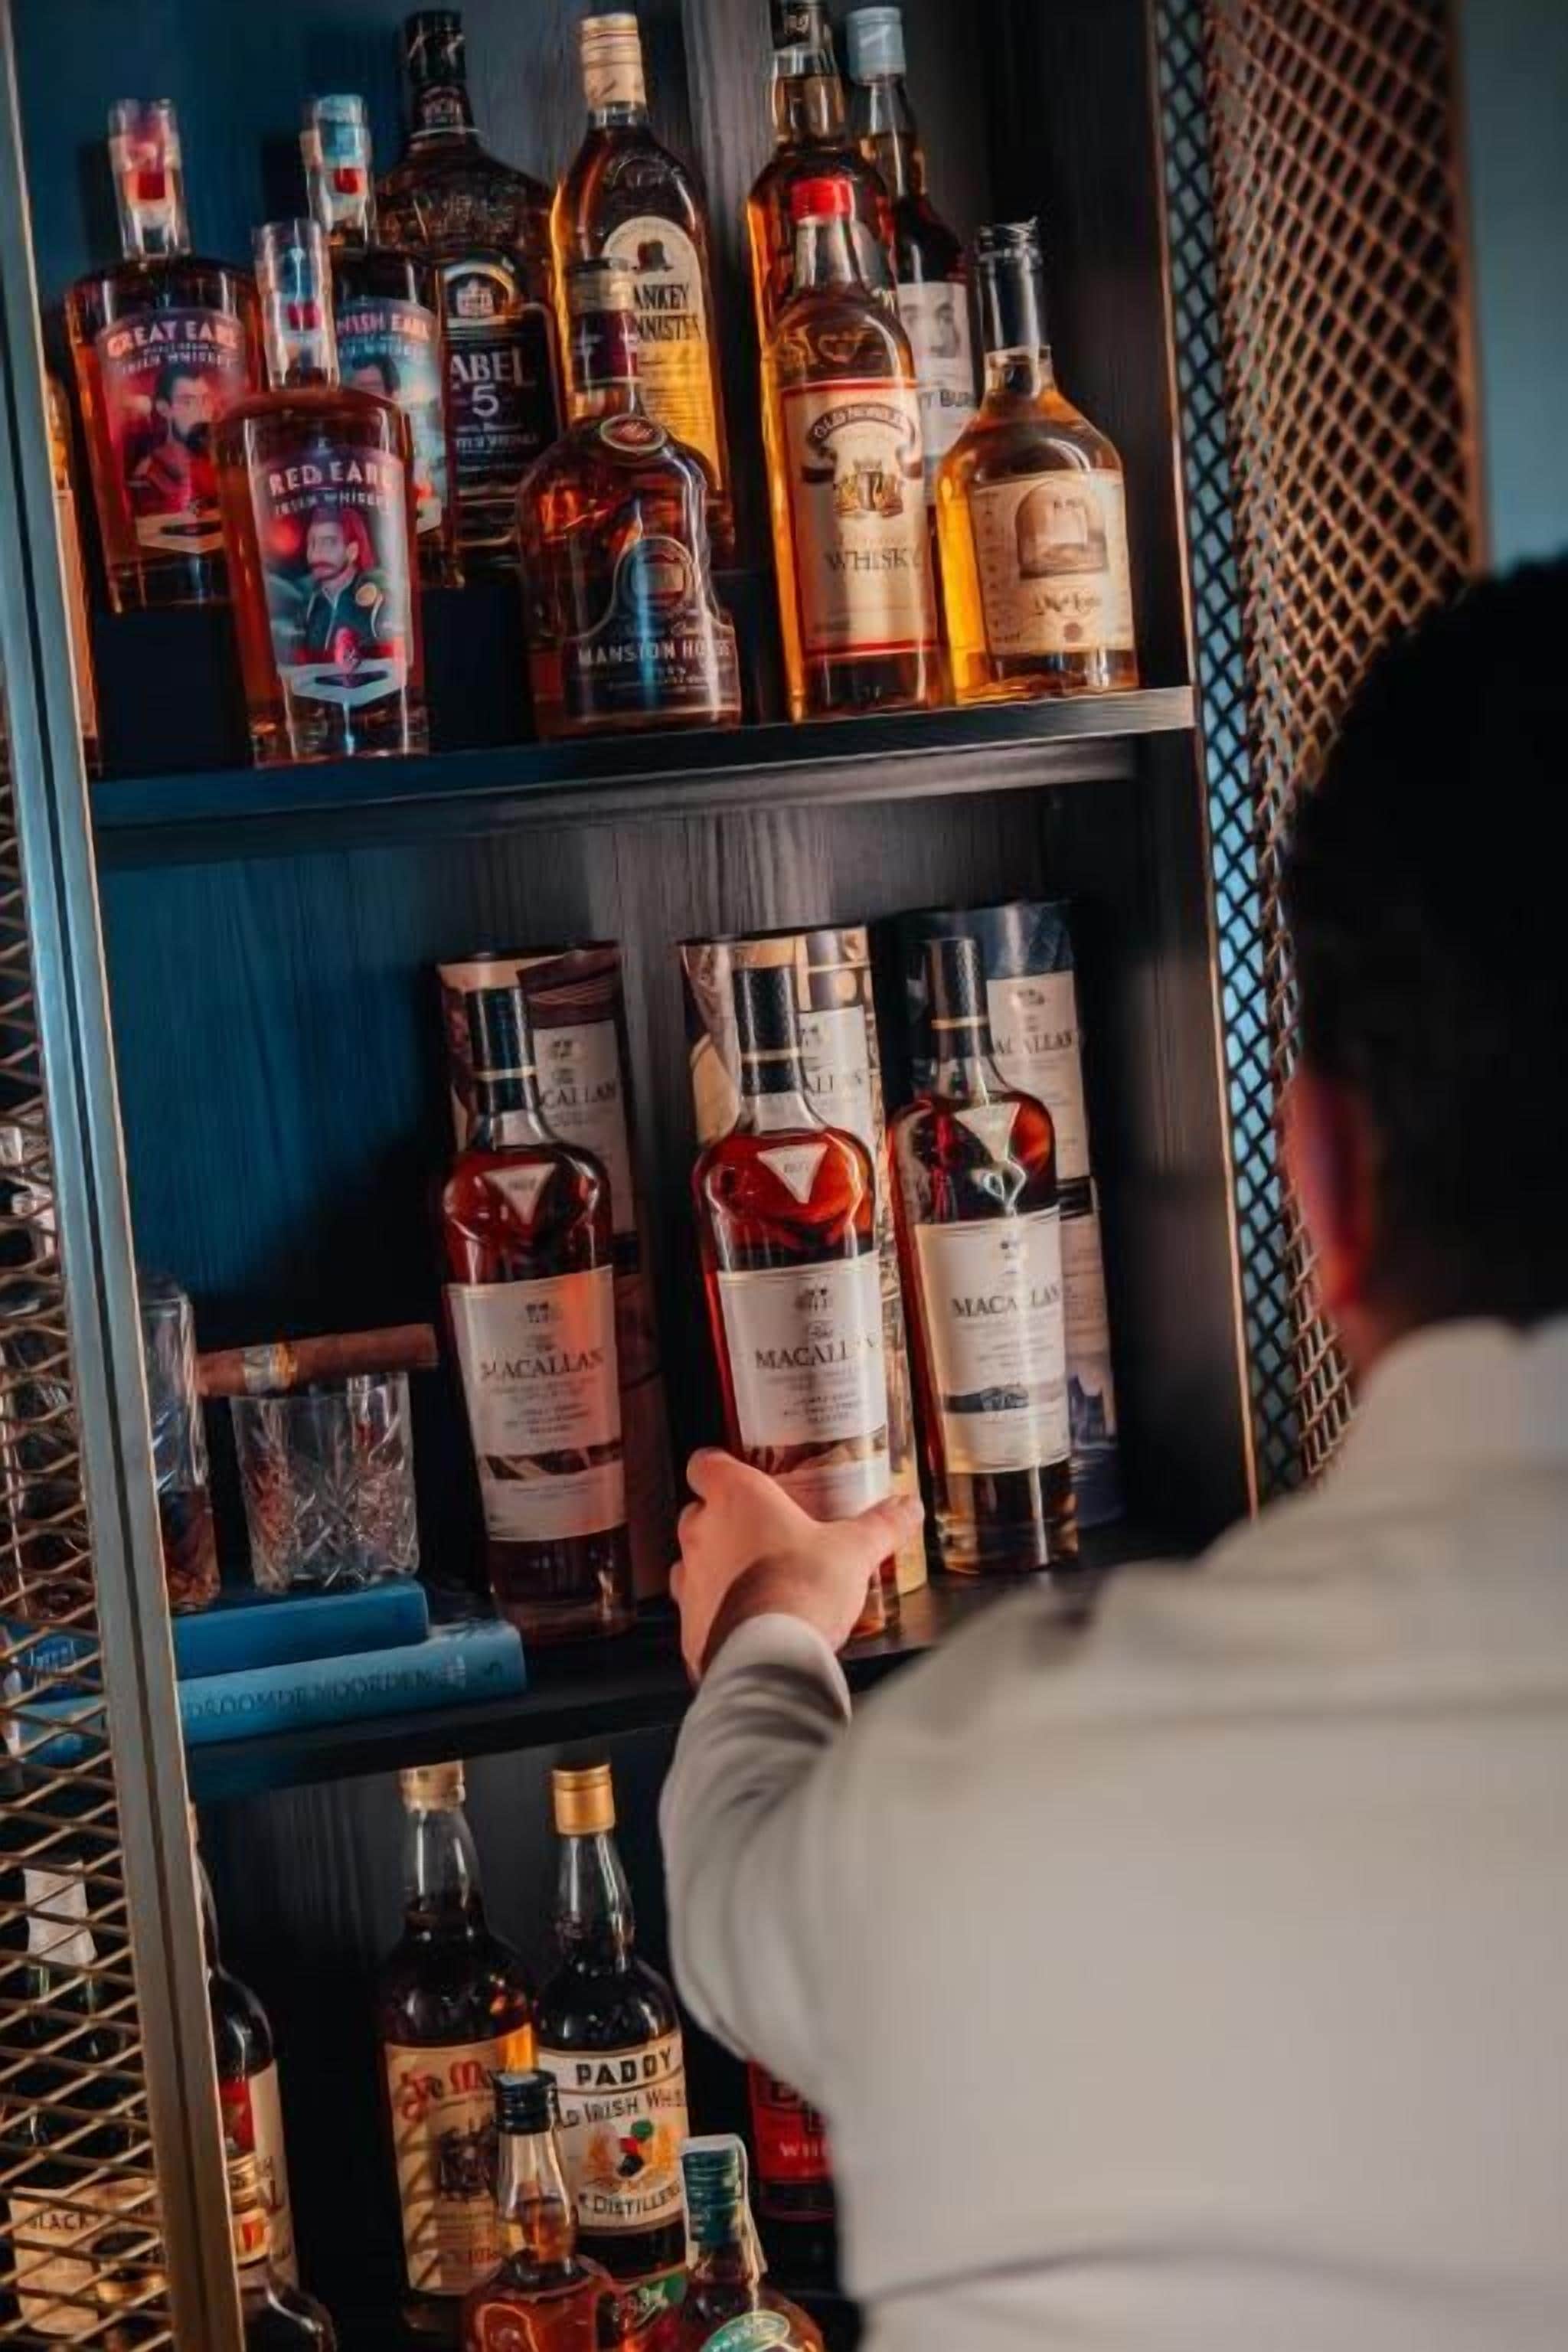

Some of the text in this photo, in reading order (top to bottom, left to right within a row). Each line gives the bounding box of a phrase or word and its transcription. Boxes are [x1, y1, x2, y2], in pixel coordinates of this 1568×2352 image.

[449, 347, 537, 387] ABEL
[471, 384, 500, 418] 5
[269, 464, 322, 497] RED
[576, 2046, 671, 2086] PADDY
